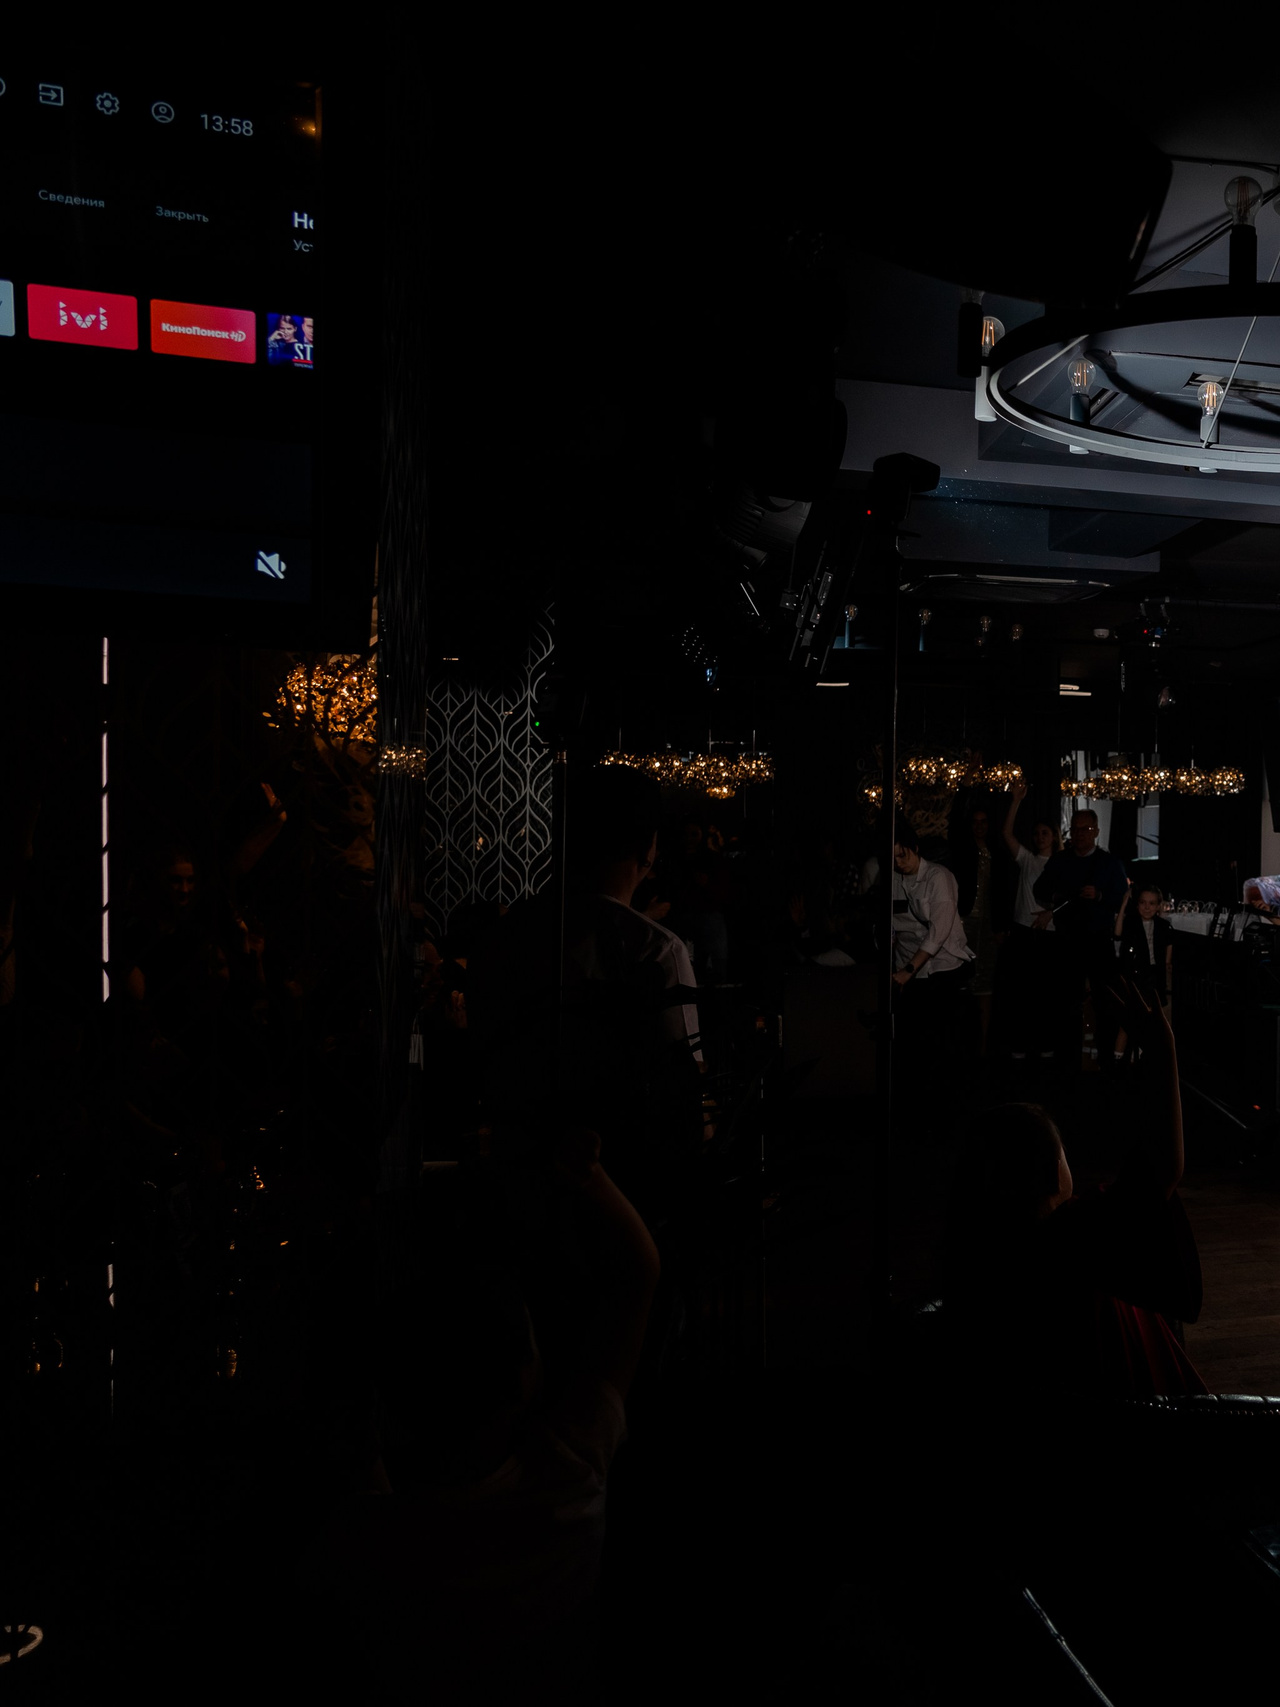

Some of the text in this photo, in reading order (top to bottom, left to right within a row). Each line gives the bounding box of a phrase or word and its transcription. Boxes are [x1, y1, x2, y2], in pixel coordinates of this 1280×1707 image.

[200, 113, 254, 137] 13:58
[38, 189, 106, 209] Сведения
[155, 206, 210, 224] Закрыть
